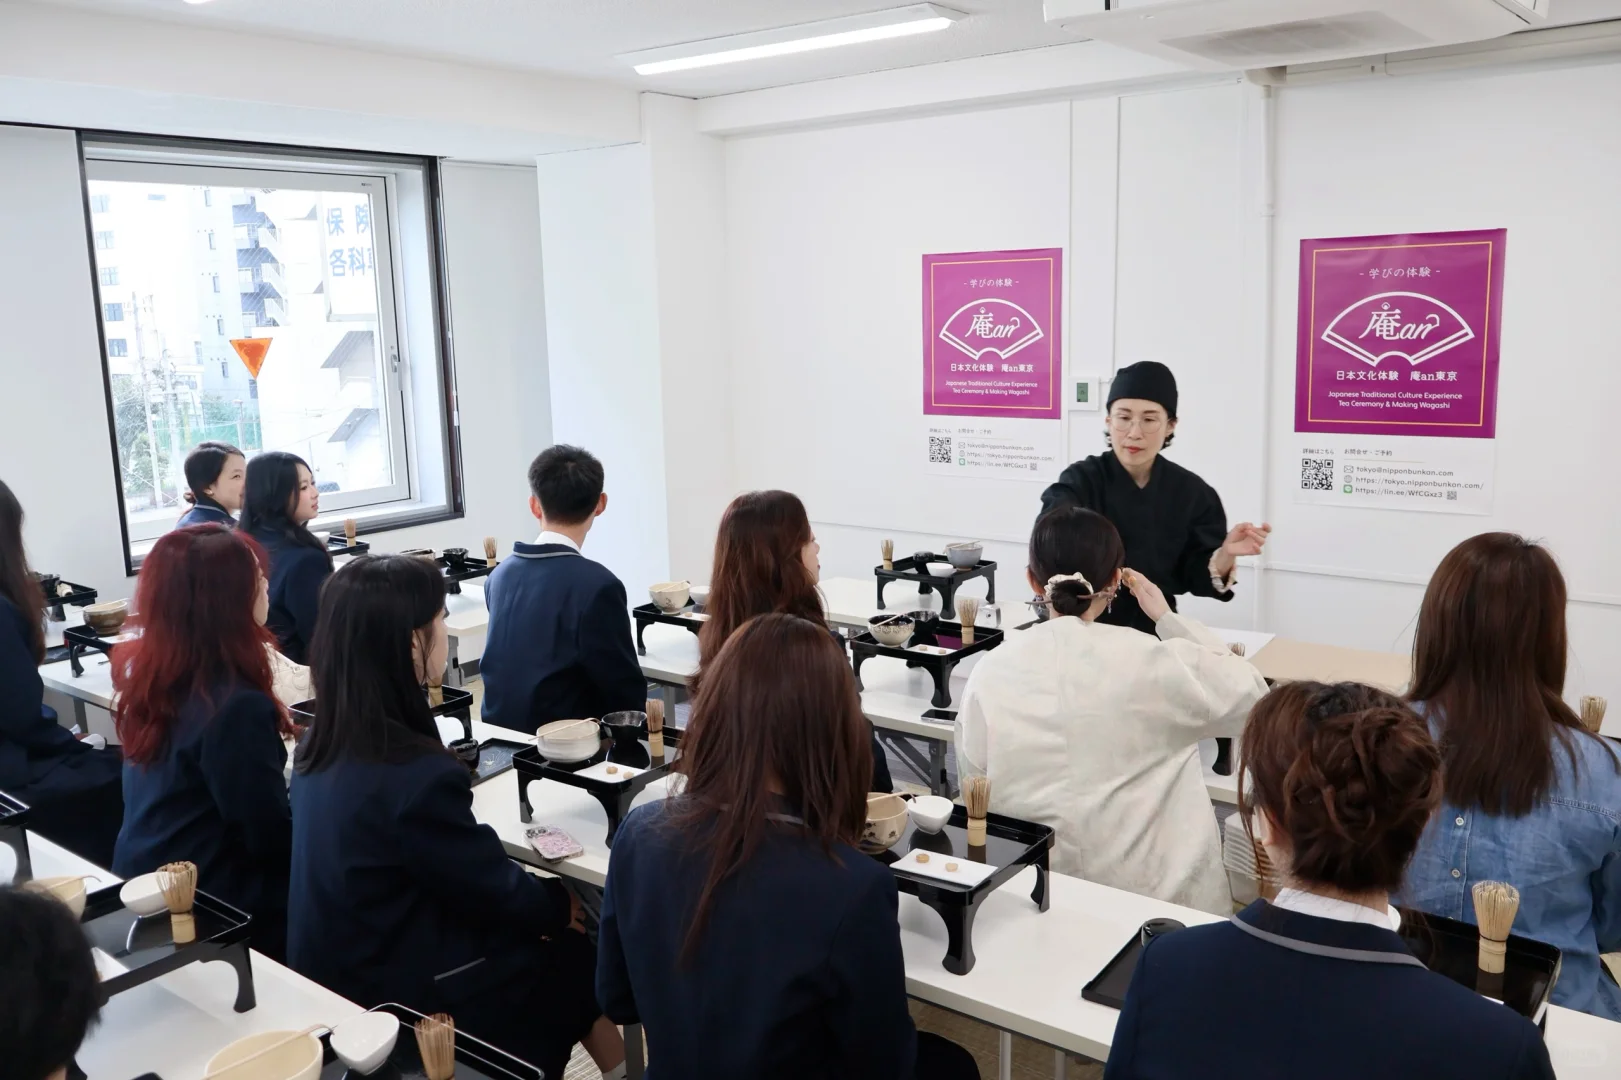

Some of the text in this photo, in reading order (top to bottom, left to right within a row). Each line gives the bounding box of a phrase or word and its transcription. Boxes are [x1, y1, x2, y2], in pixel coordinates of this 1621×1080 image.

[329, 247, 373, 277] 各科
[951, 364, 994, 372] 日本文化体験
[1336, 371, 1457, 381] 日本文化体験 庵an東京
[1328, 391, 1359, 399] Japanese
[1424, 392, 1462, 400] Experience
[1392, 401, 1418, 409] Making
[1419, 402, 1450, 410] Wagashi
[1356, 466, 1454, 477] tokyo@nipponbunkan.com
[1355, 477, 1484, 490] https://tokyo.nipponbunkan.com/
